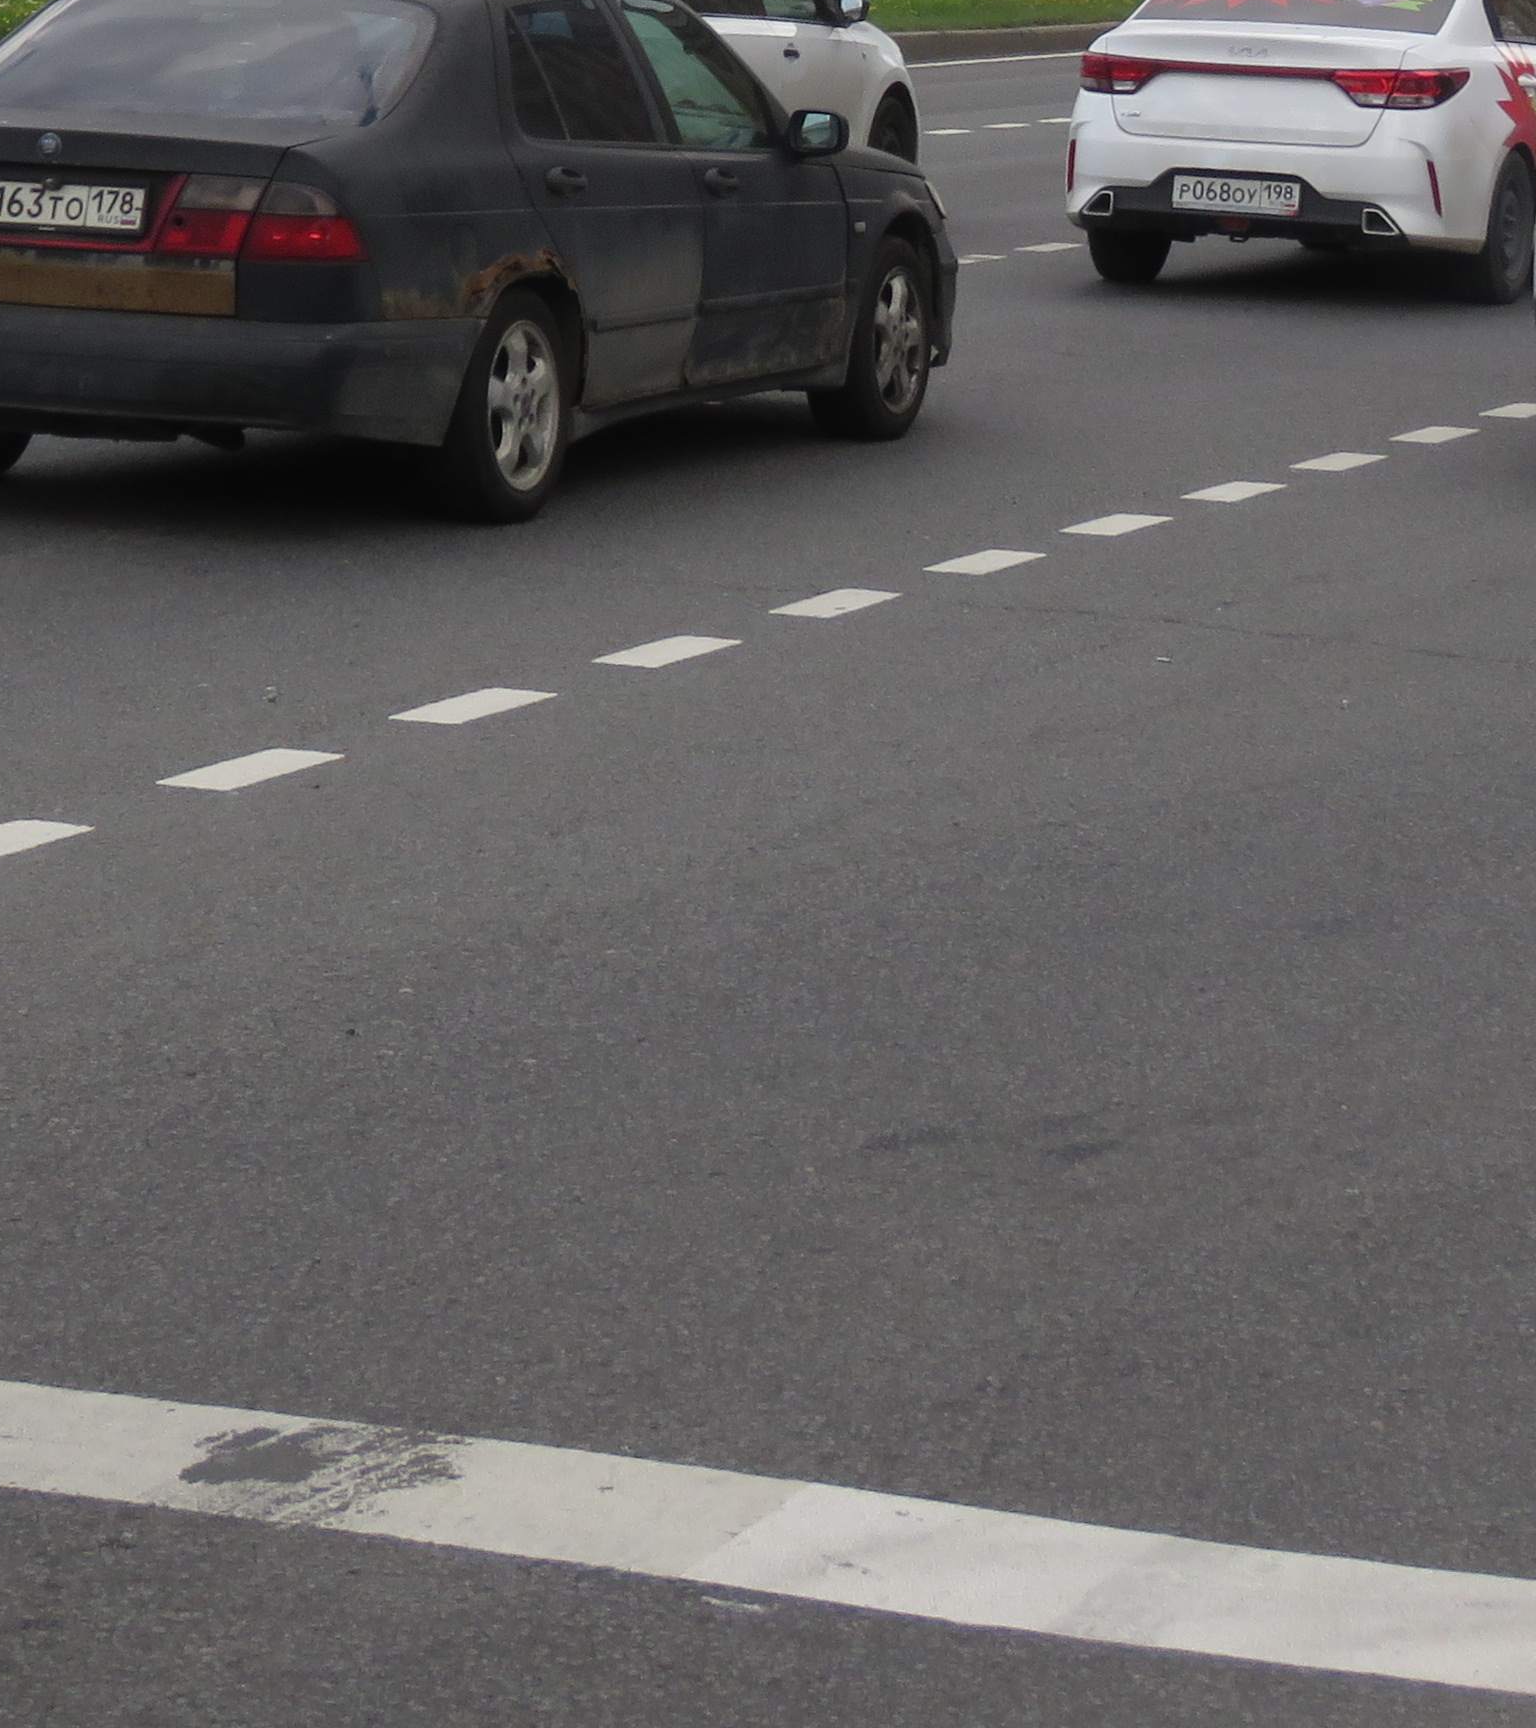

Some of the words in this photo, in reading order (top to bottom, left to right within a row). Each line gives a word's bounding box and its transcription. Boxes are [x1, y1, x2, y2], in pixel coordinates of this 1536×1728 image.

[91, 188, 135, 215] 178
[1263, 183, 1294, 202] 198
[97, 214, 120, 225] RUS
